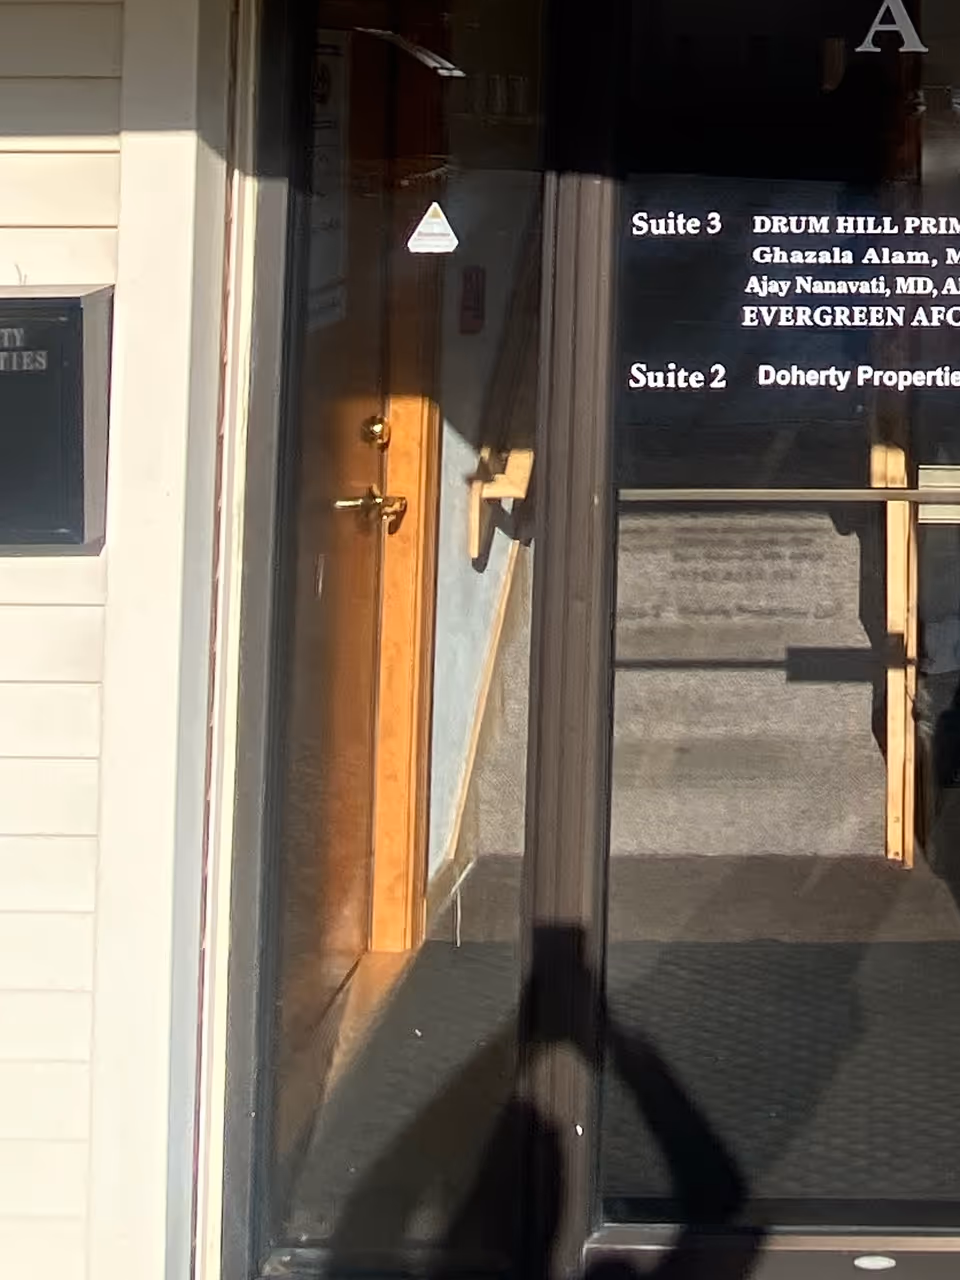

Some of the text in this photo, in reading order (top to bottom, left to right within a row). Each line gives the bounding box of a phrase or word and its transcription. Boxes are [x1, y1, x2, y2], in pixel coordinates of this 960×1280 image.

[632, 210, 701, 236] Suite
[706, 211, 722, 235] 3
[752, 215, 830, 235] DRUM
[835, 216, 899, 235] HILL
[752, 246, 854, 264] Ghazala
[861, 247, 938, 268] Alam,
[744, 275, 791, 298] Ajay
[795, 276, 891, 298] Nanavati,
[895, 277, 938, 299] MD,
[741, 305, 905, 327] EVERGREEN
[628, 362, 705, 389] Suite
[709, 363, 727, 389] 2
[758, 364, 852, 392] Doherty
